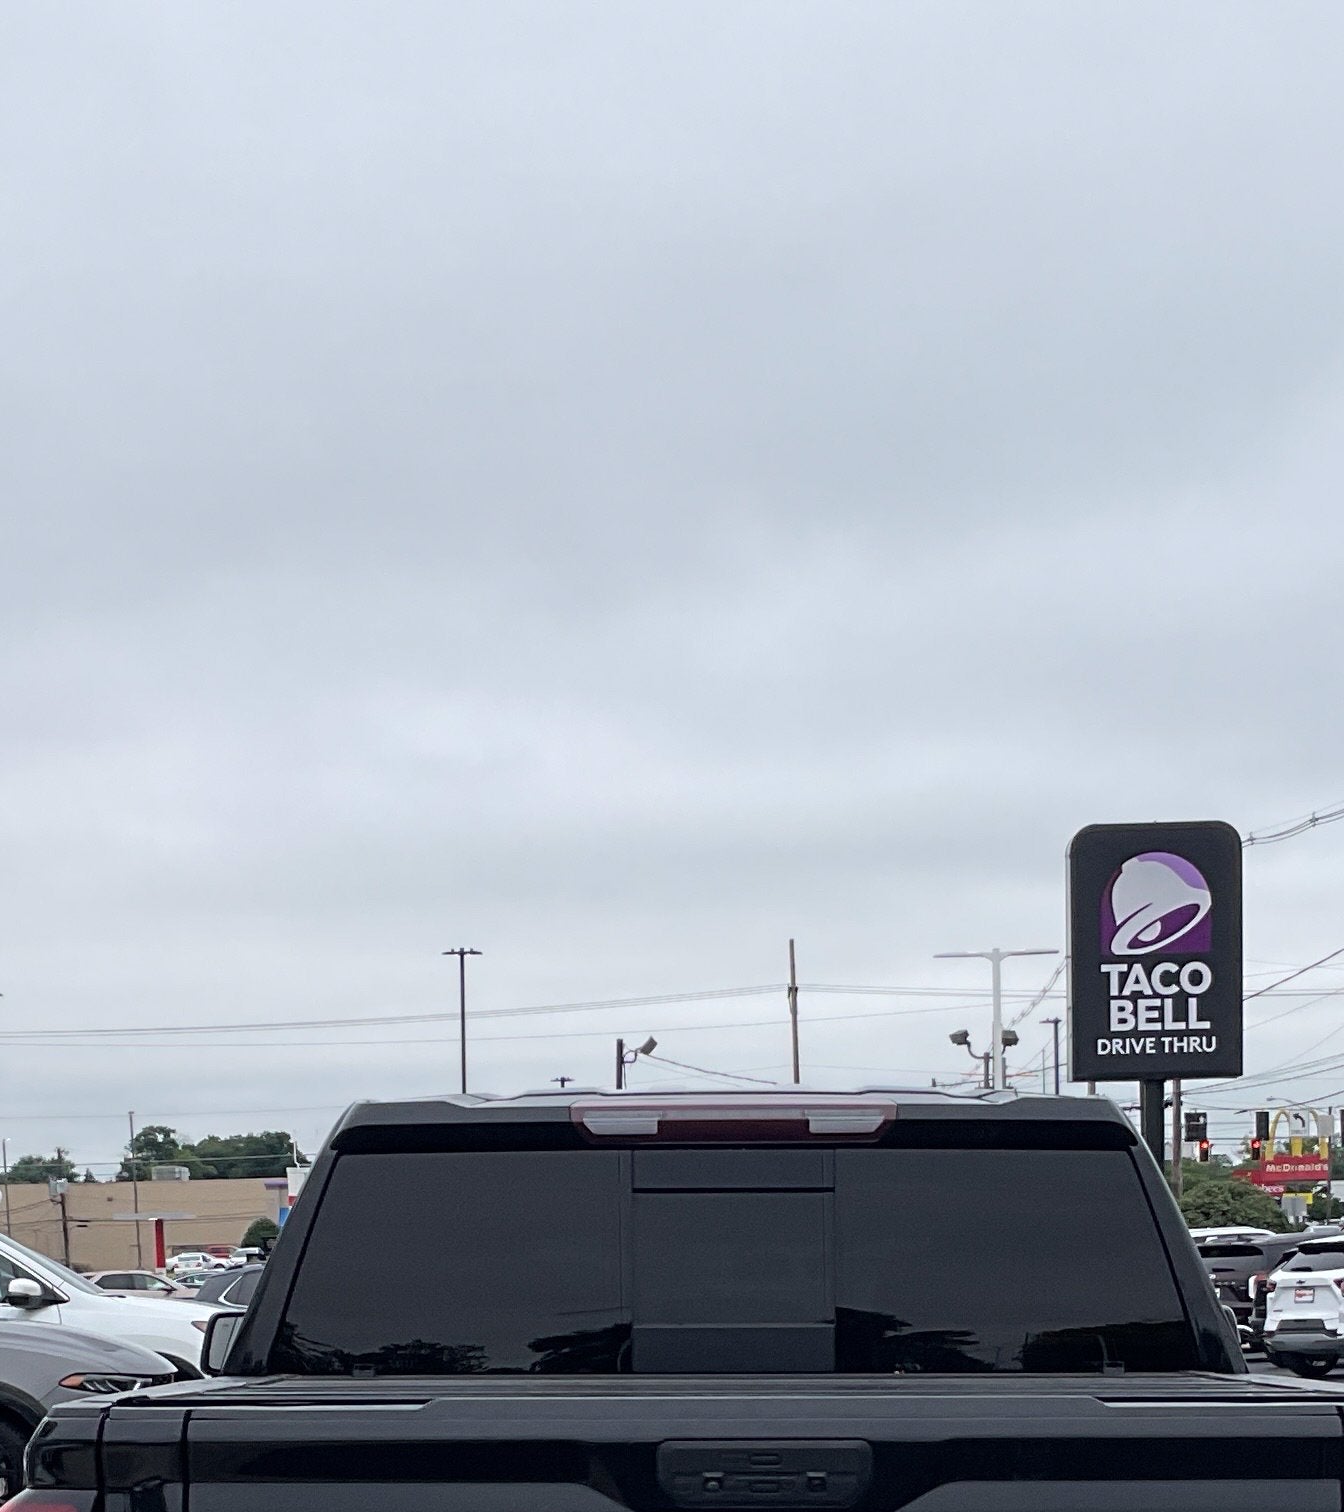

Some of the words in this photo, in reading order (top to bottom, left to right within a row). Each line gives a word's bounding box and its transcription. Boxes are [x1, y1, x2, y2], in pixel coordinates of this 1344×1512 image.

[1100, 961, 1212, 996] TACO
[1110, 998, 1211, 1031] BELL
[1097, 1038, 1156, 1055] DRIVE
[1161, 1036, 1217, 1053] THRU
